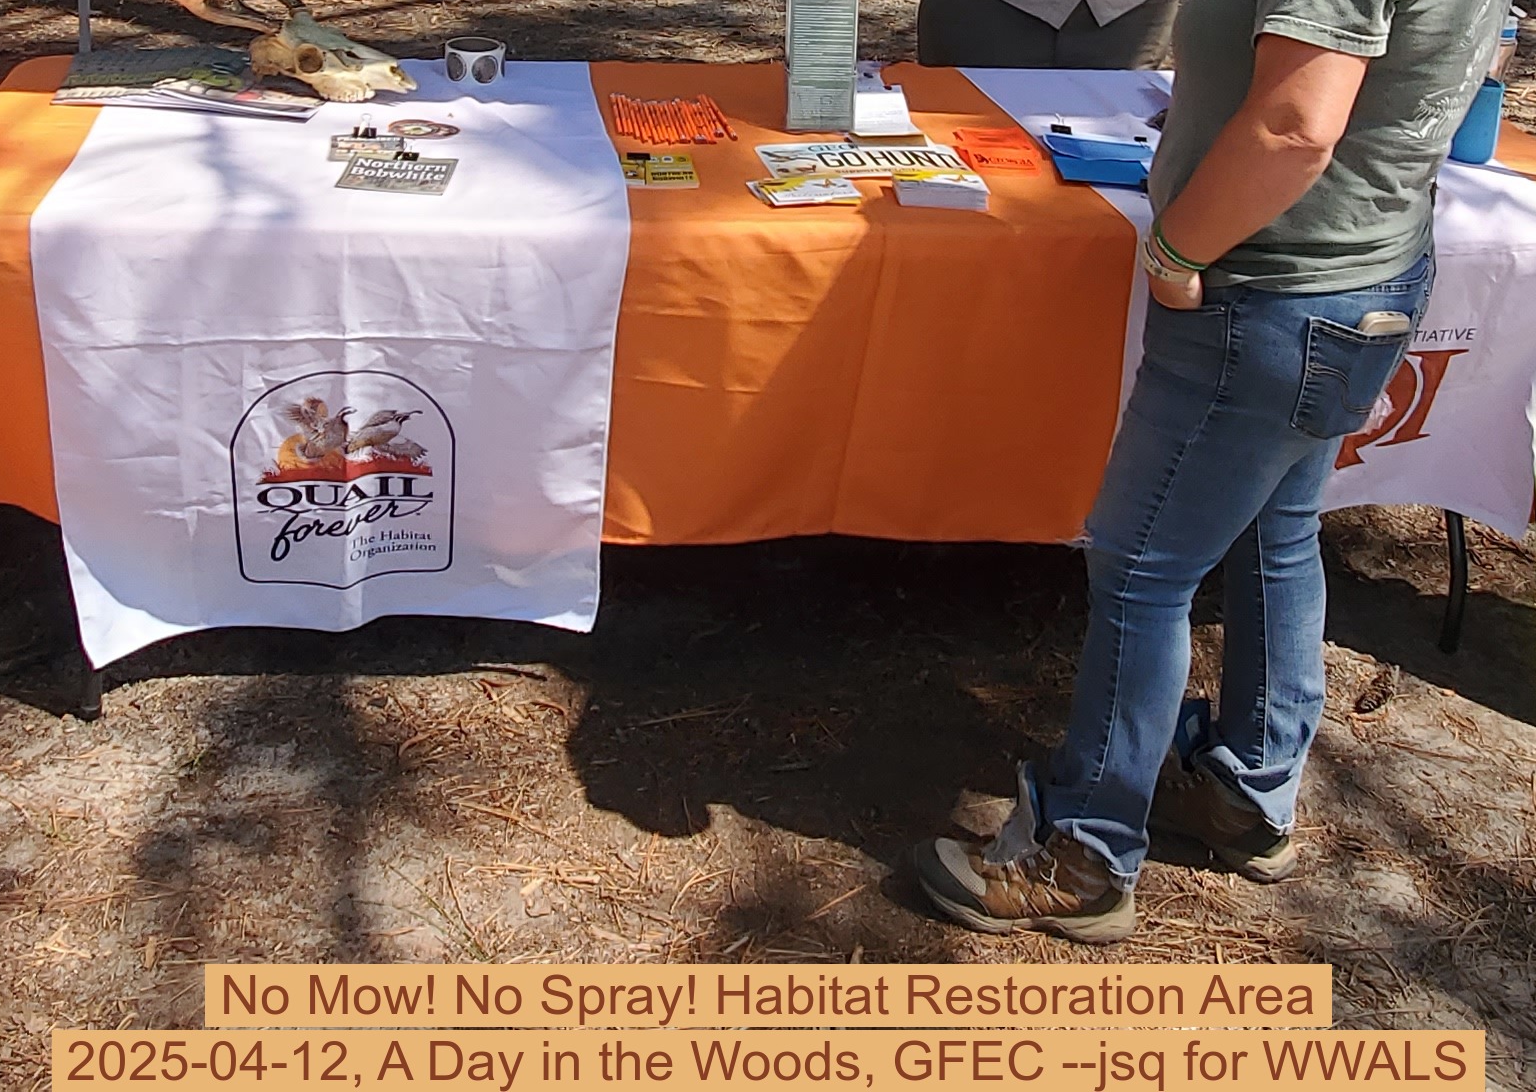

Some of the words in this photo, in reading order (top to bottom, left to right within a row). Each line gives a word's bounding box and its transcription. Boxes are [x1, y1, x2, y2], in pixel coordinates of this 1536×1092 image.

[356, 158, 447, 172] Northern
[816, 151, 866, 168] GO
[350, 167, 445, 181] Bobwhite
[1413, 328, 1477, 342] TIATIVE
[257, 476, 434, 508] QUAIL
[268, 500, 433, 562] forever
[351, 532, 375, 549] The
[380, 530, 432, 542] Habitat
[350, 541, 437, 561] Organization
